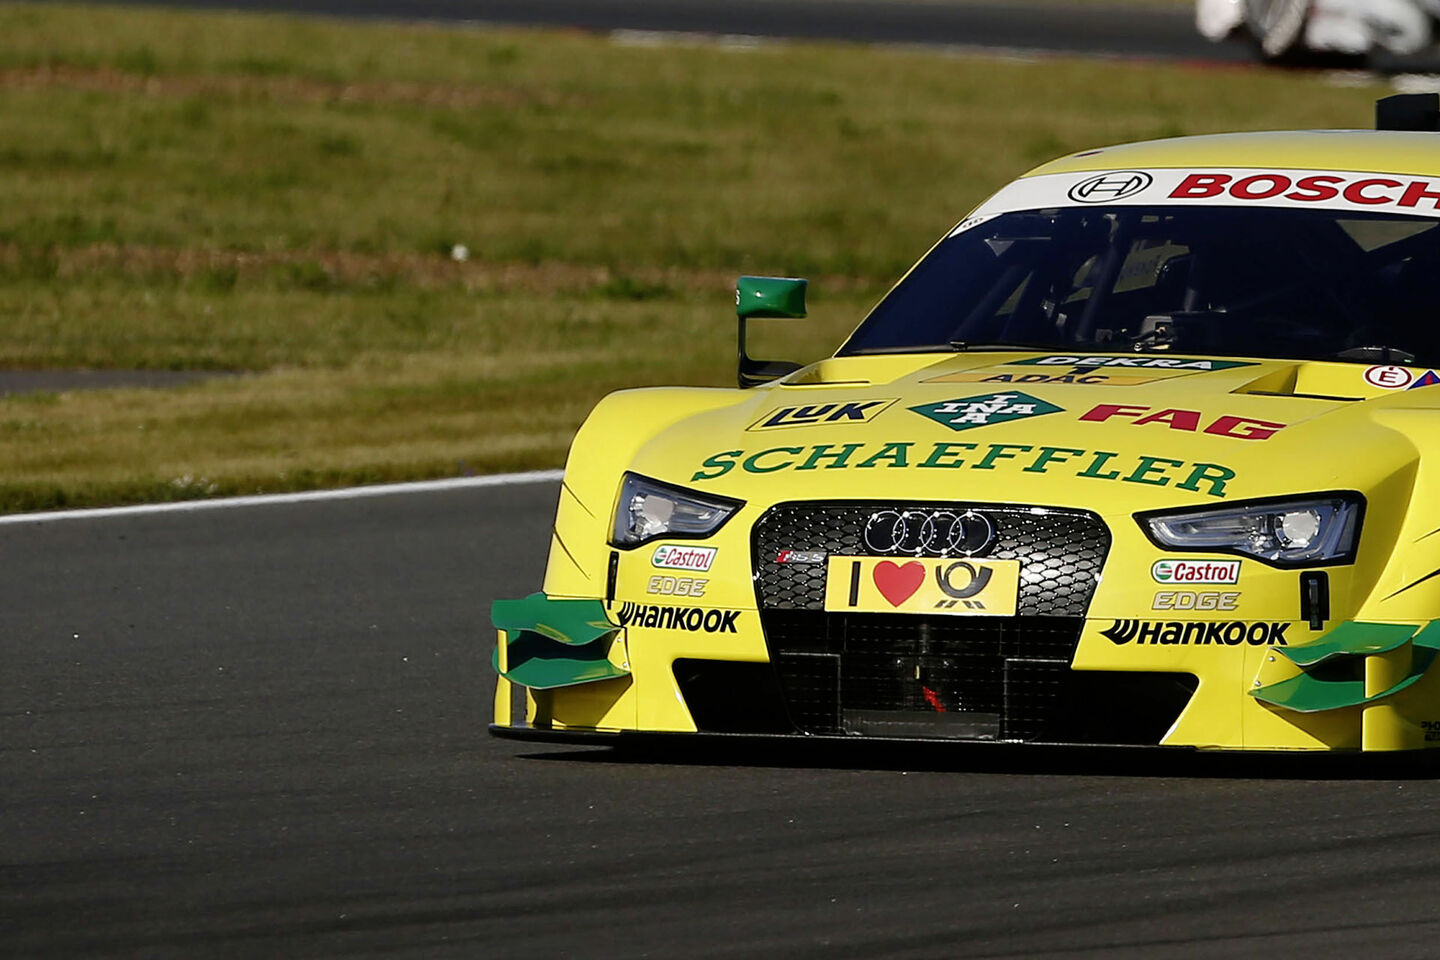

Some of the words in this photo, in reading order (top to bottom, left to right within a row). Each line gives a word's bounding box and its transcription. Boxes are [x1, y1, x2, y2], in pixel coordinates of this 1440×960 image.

[1036, 356, 1213, 370] DEKRA
[980, 374, 1110, 384] ADAC
[1077, 403, 1288, 441] FAG
[689, 441, 1238, 498] SCHAEFFLER
[665, 547, 712, 571] Castrol
[1173, 561, 1237, 583] Castrol
[647, 575, 710, 597] EDGE
[848, 560, 862, 607] I
[1151, 591, 1241, 612] EDGE
